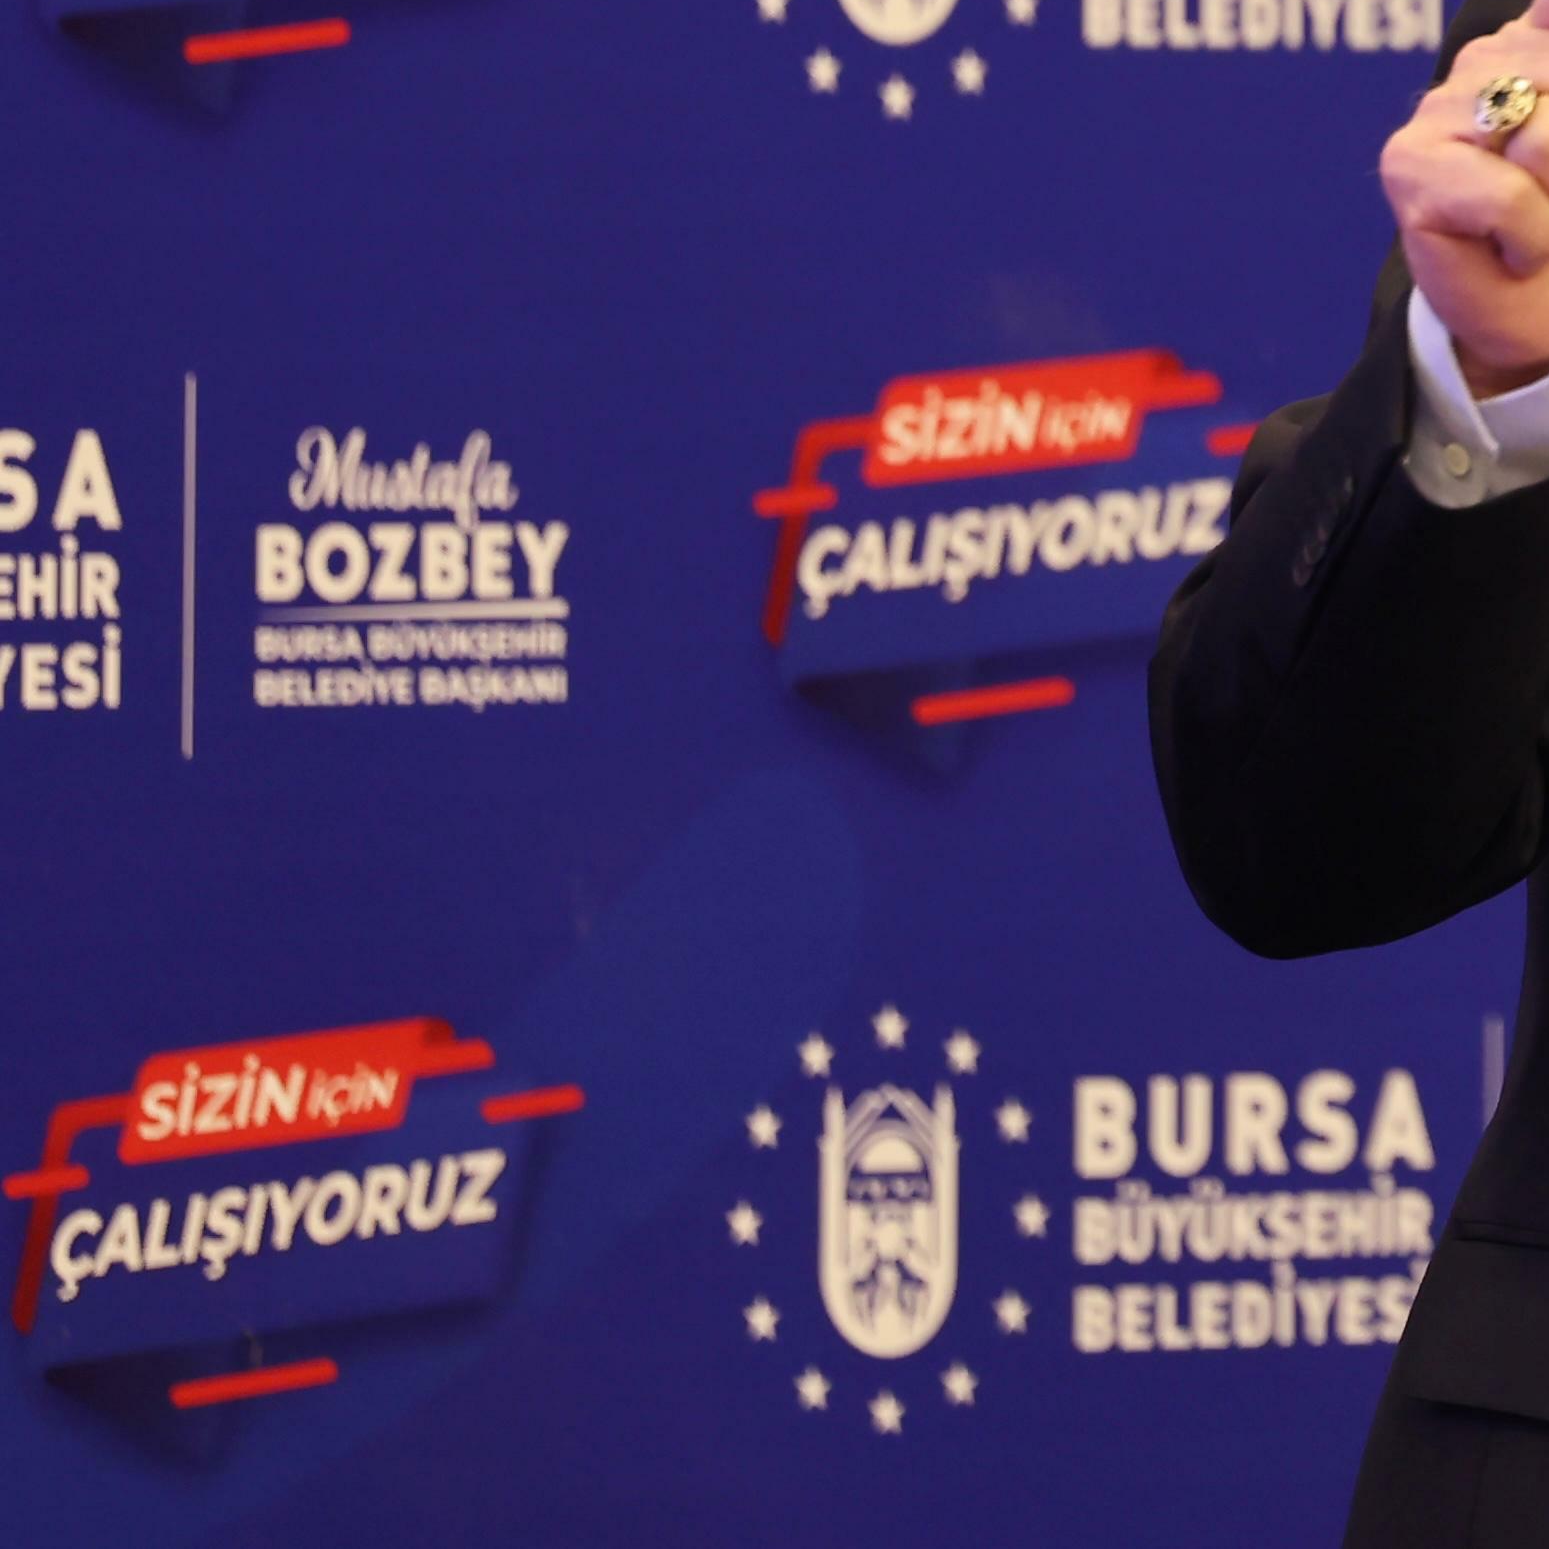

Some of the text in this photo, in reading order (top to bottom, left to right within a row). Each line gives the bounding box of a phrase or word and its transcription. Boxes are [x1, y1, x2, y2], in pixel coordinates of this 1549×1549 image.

[880, 381, 1042, 466] SİZİN
[289, 427, 518, 530] Mustafa
[256, 521, 569, 602] BOZBEY
[798, 477, 1231, 619] ÇALIŞIYORUZ
[137, 1053, 399, 1141] SİZİN İÇİN
[1073, 1069, 1435, 1180] BURSA
[50, 1148, 506, 1302] ÇALIŞIYORUZ
[1073, 1172, 1434, 1265] BÜYÜKŞEHİR
